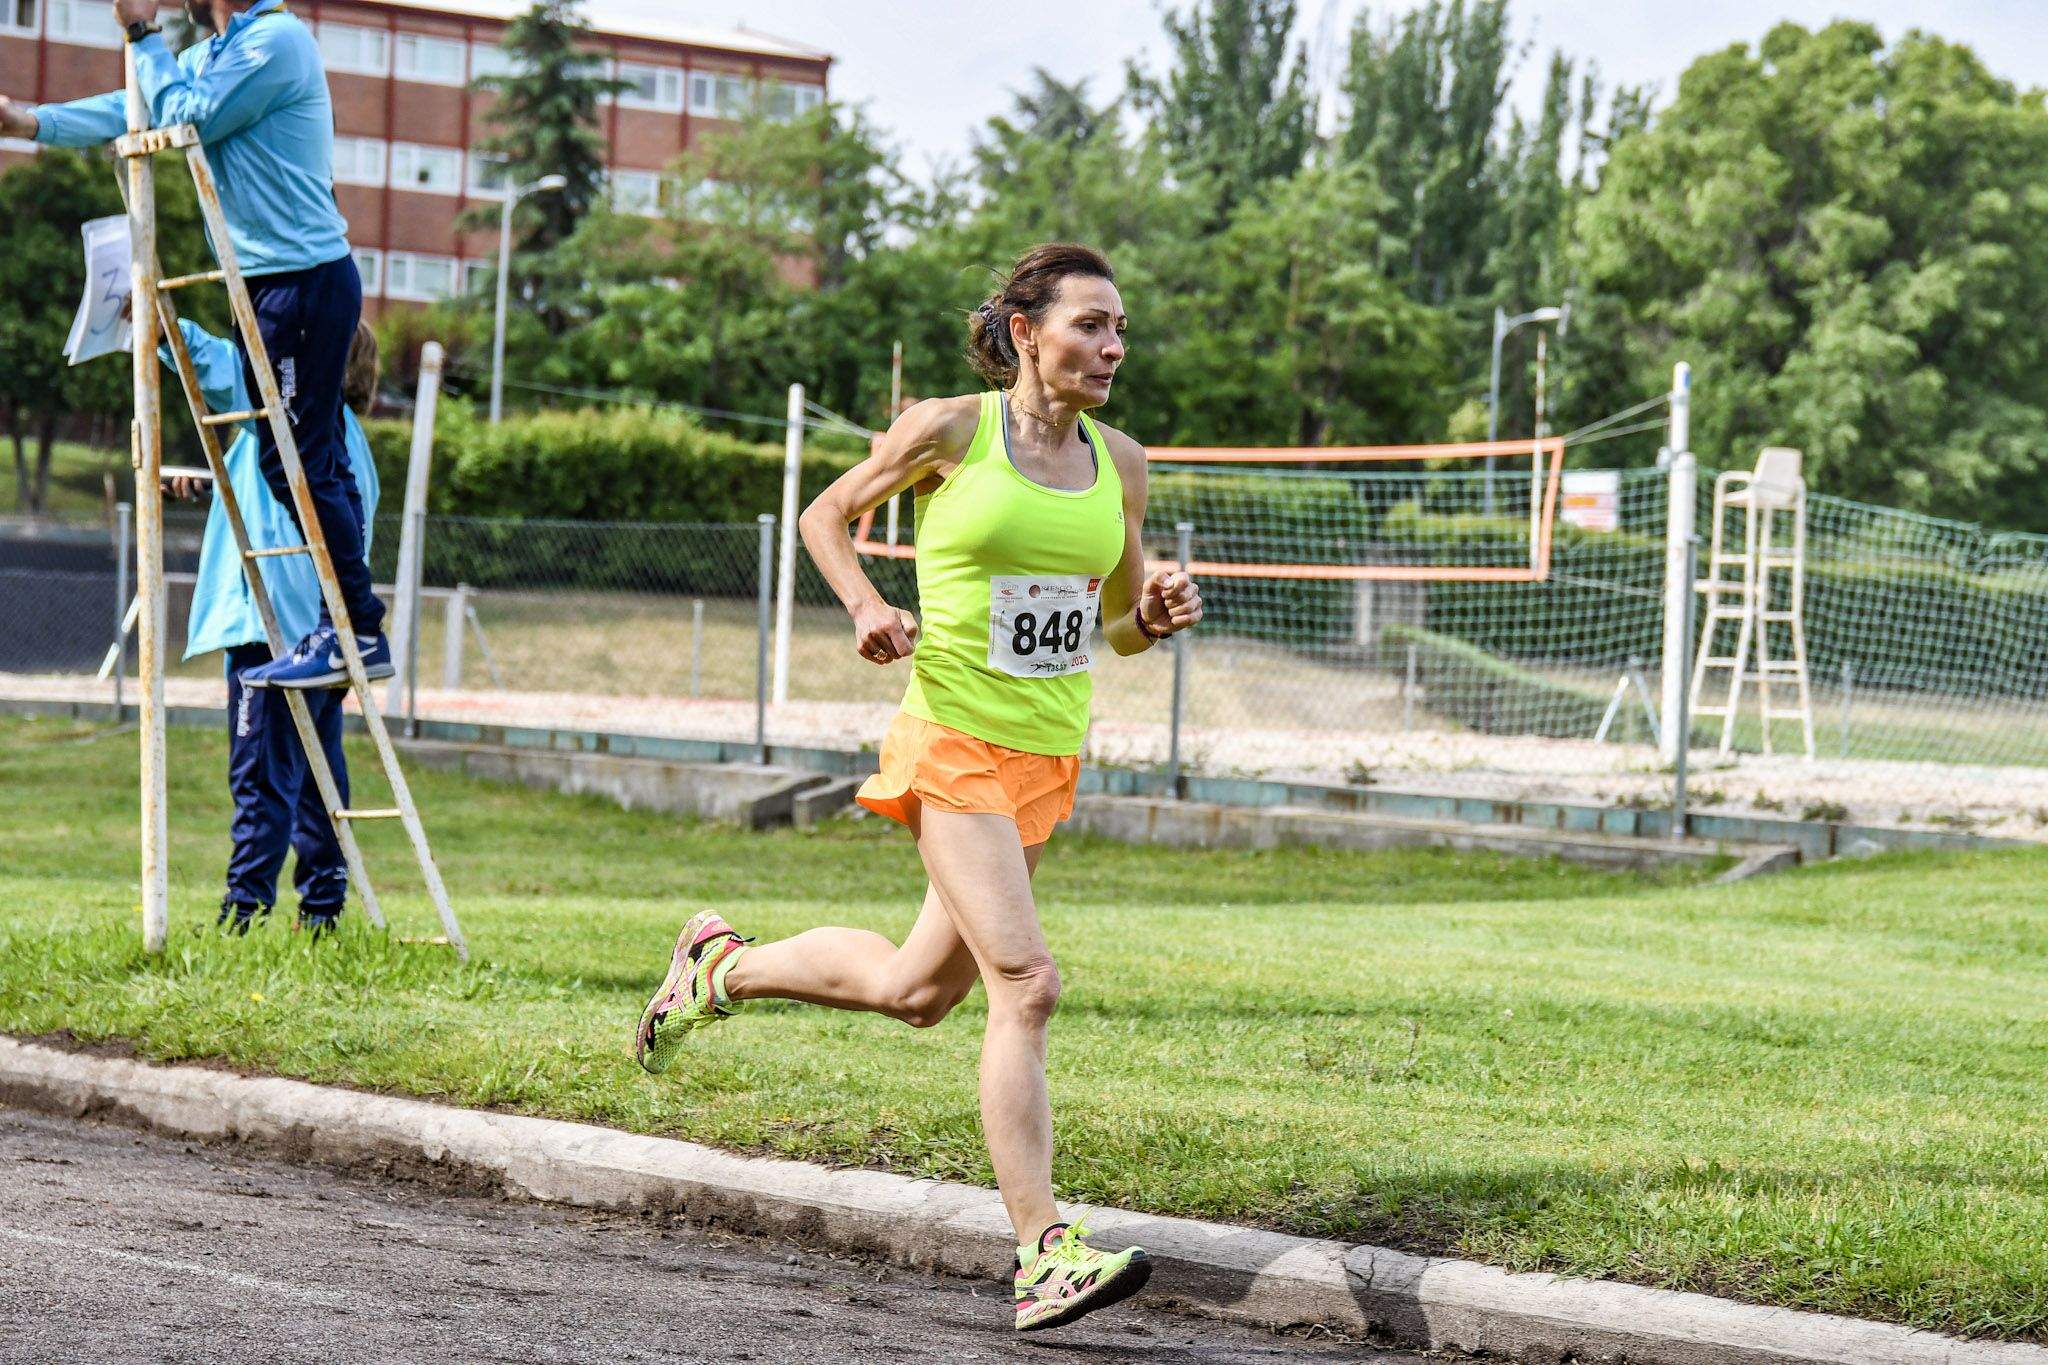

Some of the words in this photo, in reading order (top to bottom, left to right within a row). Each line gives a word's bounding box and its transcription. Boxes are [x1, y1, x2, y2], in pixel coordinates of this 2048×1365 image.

[91, 267, 122, 335] 3
[1012, 609, 1083, 656] 848
[1071, 654, 1090, 667] 2023
